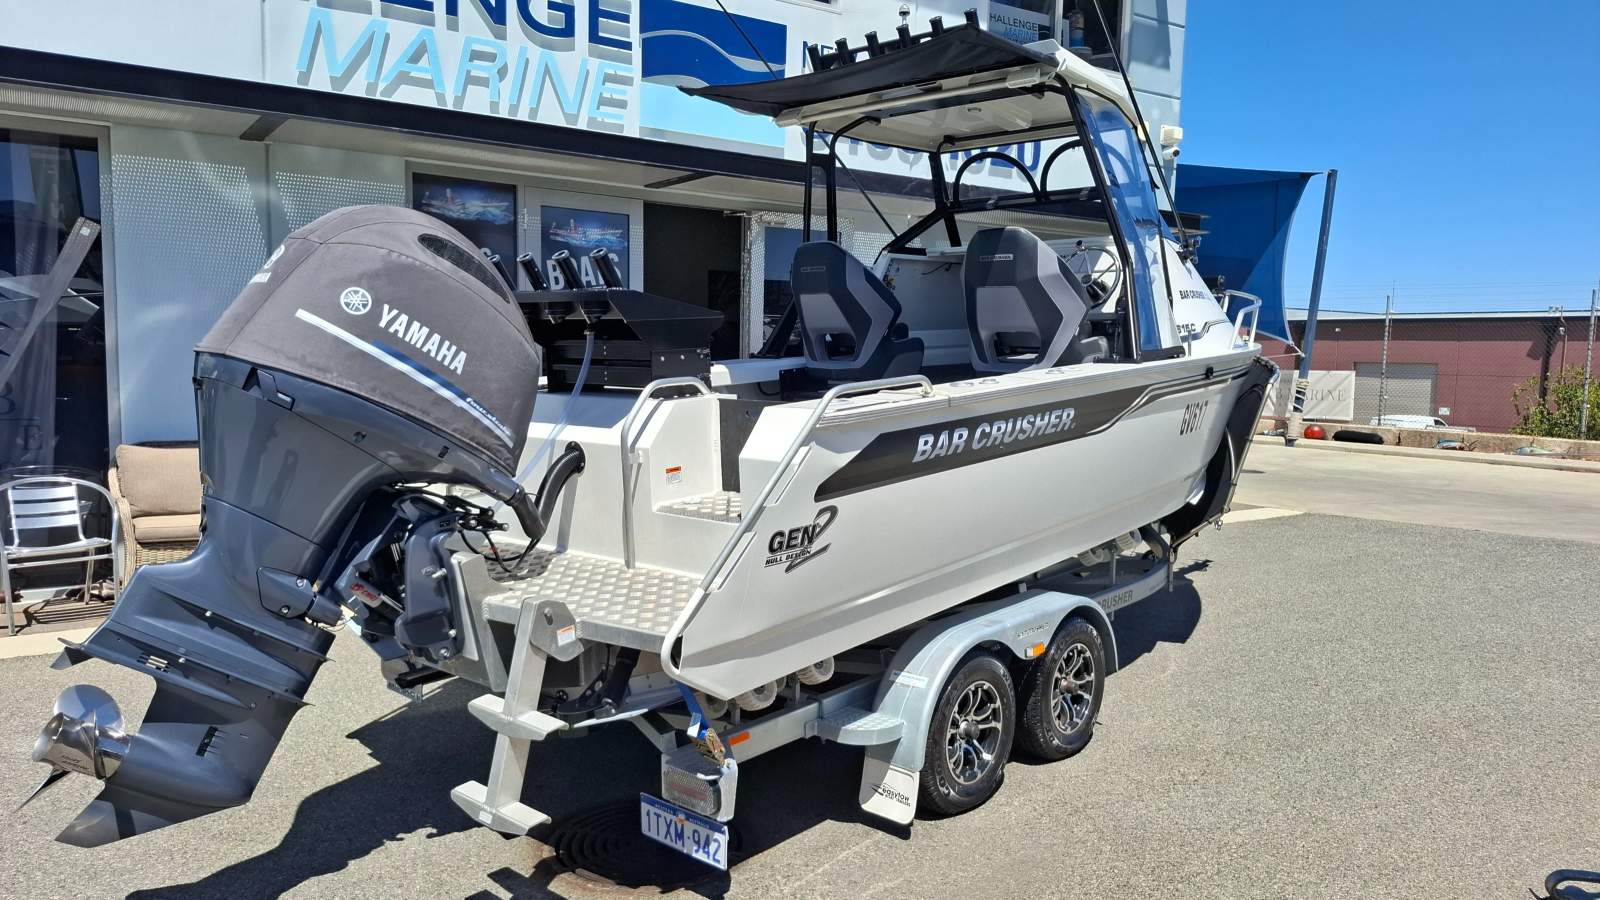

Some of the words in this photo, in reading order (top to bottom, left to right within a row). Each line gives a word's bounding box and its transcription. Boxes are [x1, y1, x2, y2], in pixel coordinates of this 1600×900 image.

[296, 6, 635, 122] MARINE
[378, 303, 468, 375] YAMAHA
[912, 427, 969, 464] BAR
[972, 407, 1075, 450] CRUSHER
[768, 524, 818, 555] GEN
